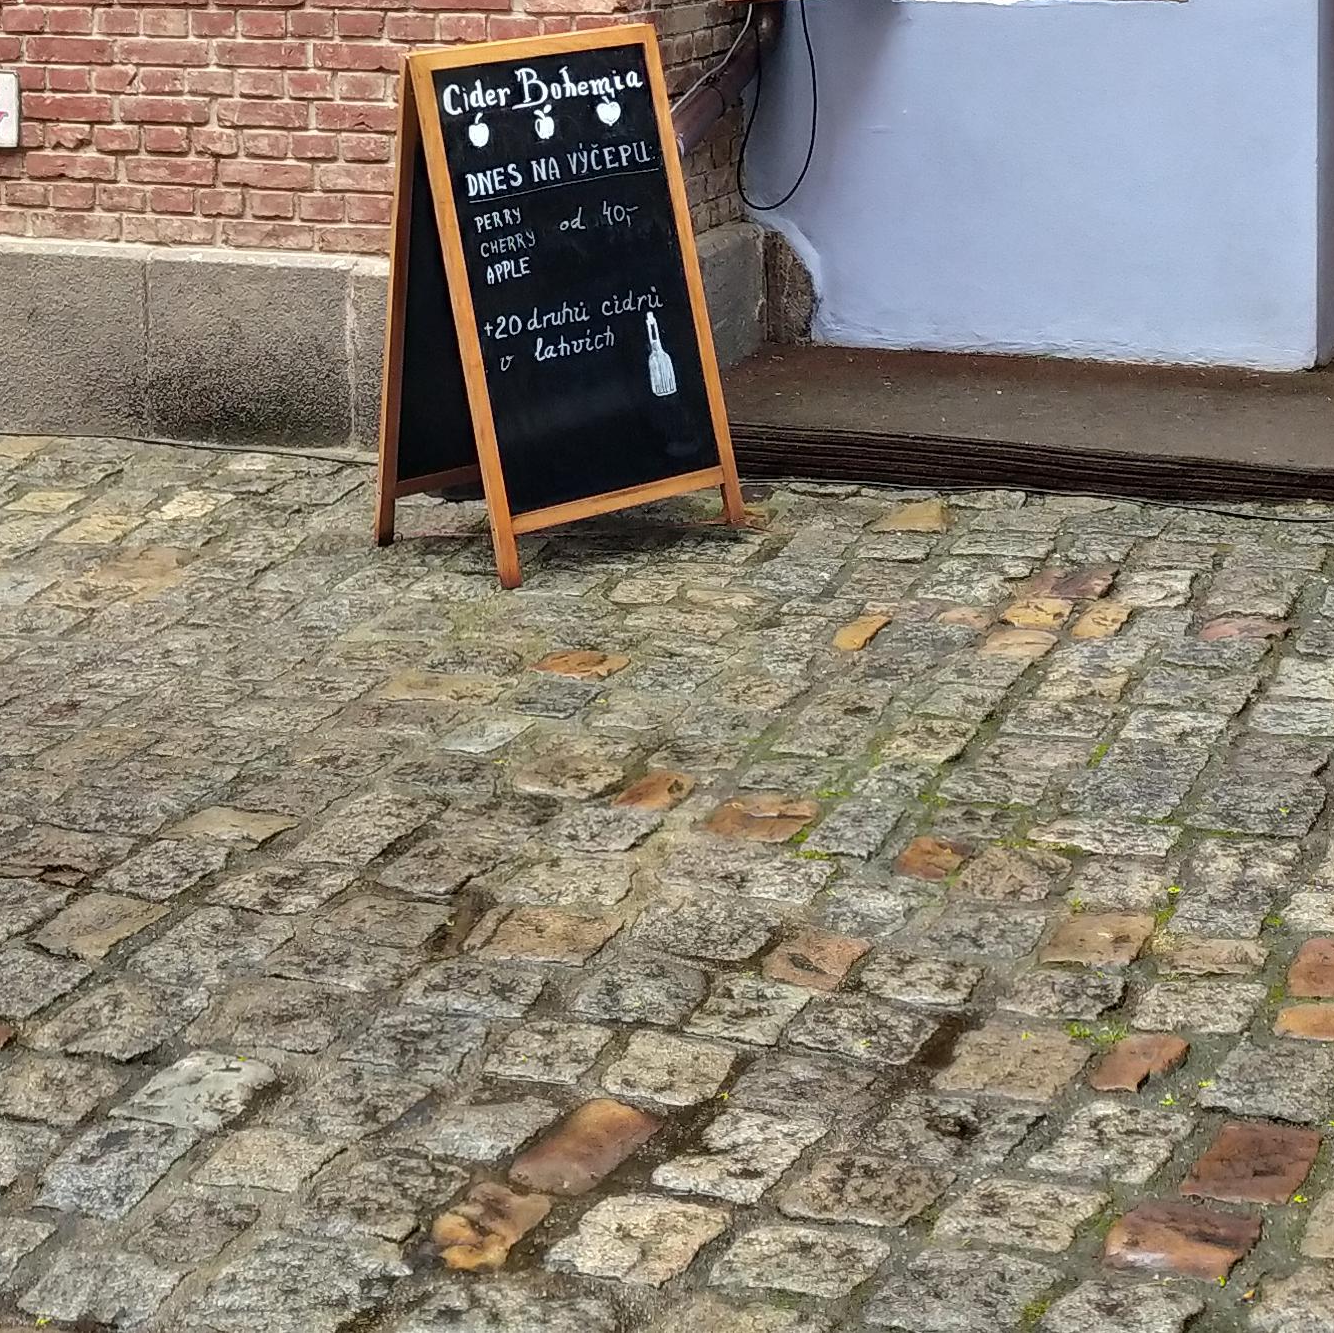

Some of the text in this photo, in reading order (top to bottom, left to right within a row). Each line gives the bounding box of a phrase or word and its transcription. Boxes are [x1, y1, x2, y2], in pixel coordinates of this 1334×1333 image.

[442, 66, 644, 116] Cider Bohemia
[465, 163, 524, 197] DNES
[530, 158, 561, 184] NA
[474, 207, 523, 234] PERRY
[559, 207, 586, 231] od
[480, 230, 537, 259] CHERRY
[485, 256, 532, 285] APPLE
[601, 285, 665, 317] cidrů
[499, 354, 515, 372] v
